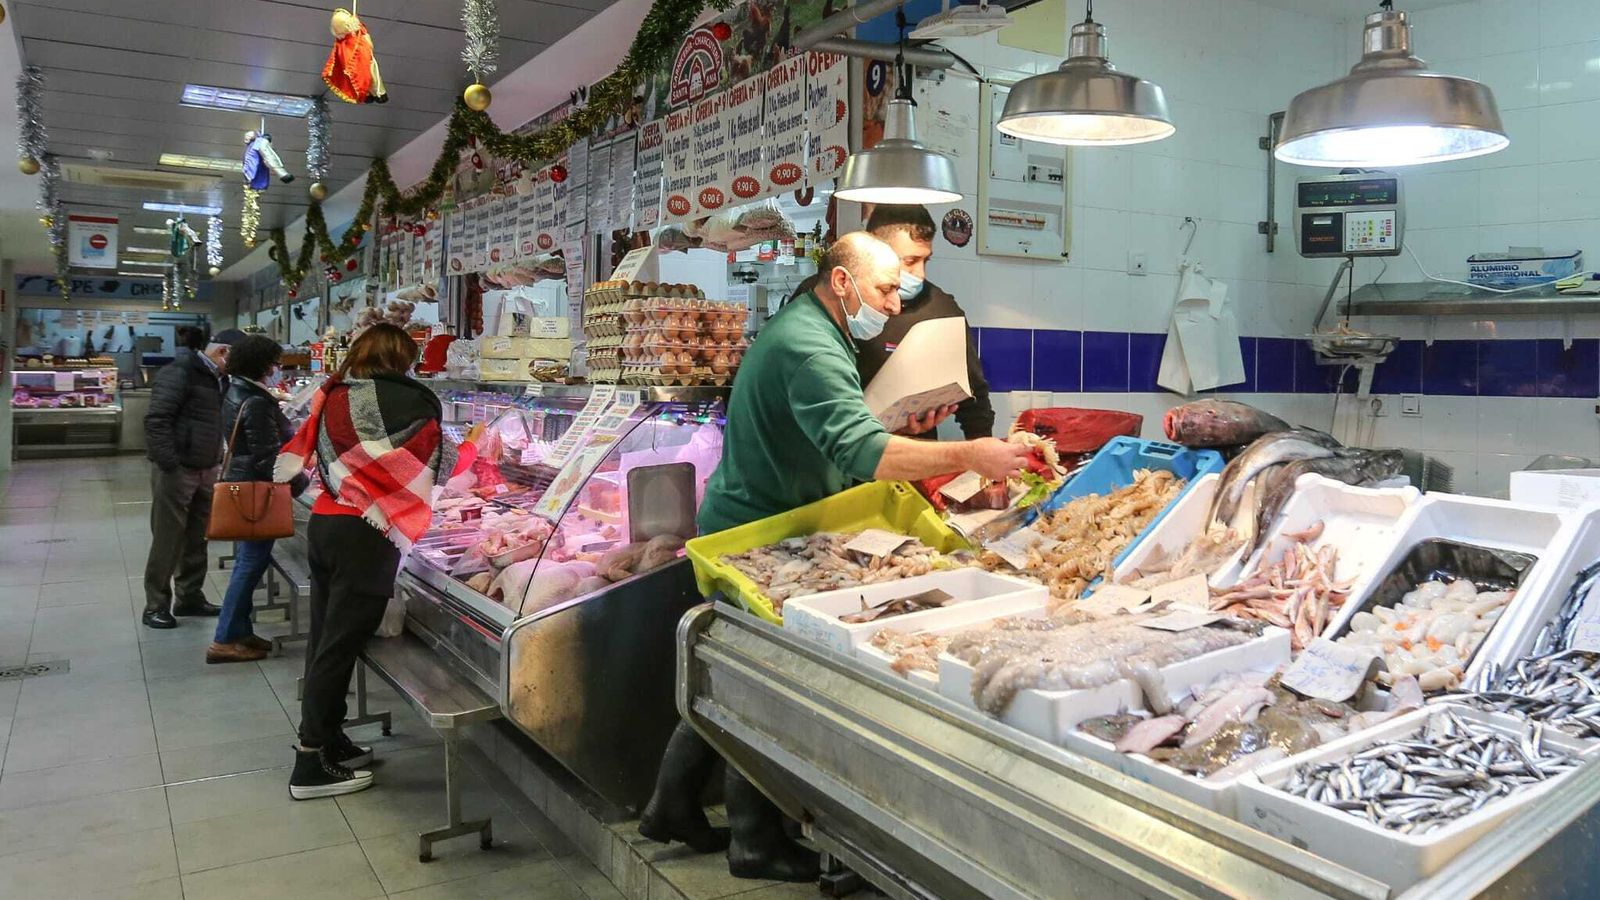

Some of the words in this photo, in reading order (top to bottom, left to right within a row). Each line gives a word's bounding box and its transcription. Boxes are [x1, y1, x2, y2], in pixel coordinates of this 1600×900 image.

[672, 86, 688, 101] SANTA
[705, 72, 717, 86] ANA
[767, 65, 789, 92] OFERTA
[872, 64, 881, 90] 9
[695, 99, 714, 123] OFERTA
[722, 92, 726, 111] 9
[729, 84, 749, 109] OFERTA
[642, 122, 660, 138] OFERTA
[665, 111, 684, 133] OFERTA
[792, 167, 797, 178] €
[1470, 264, 1520, 273] ALUMINIO
